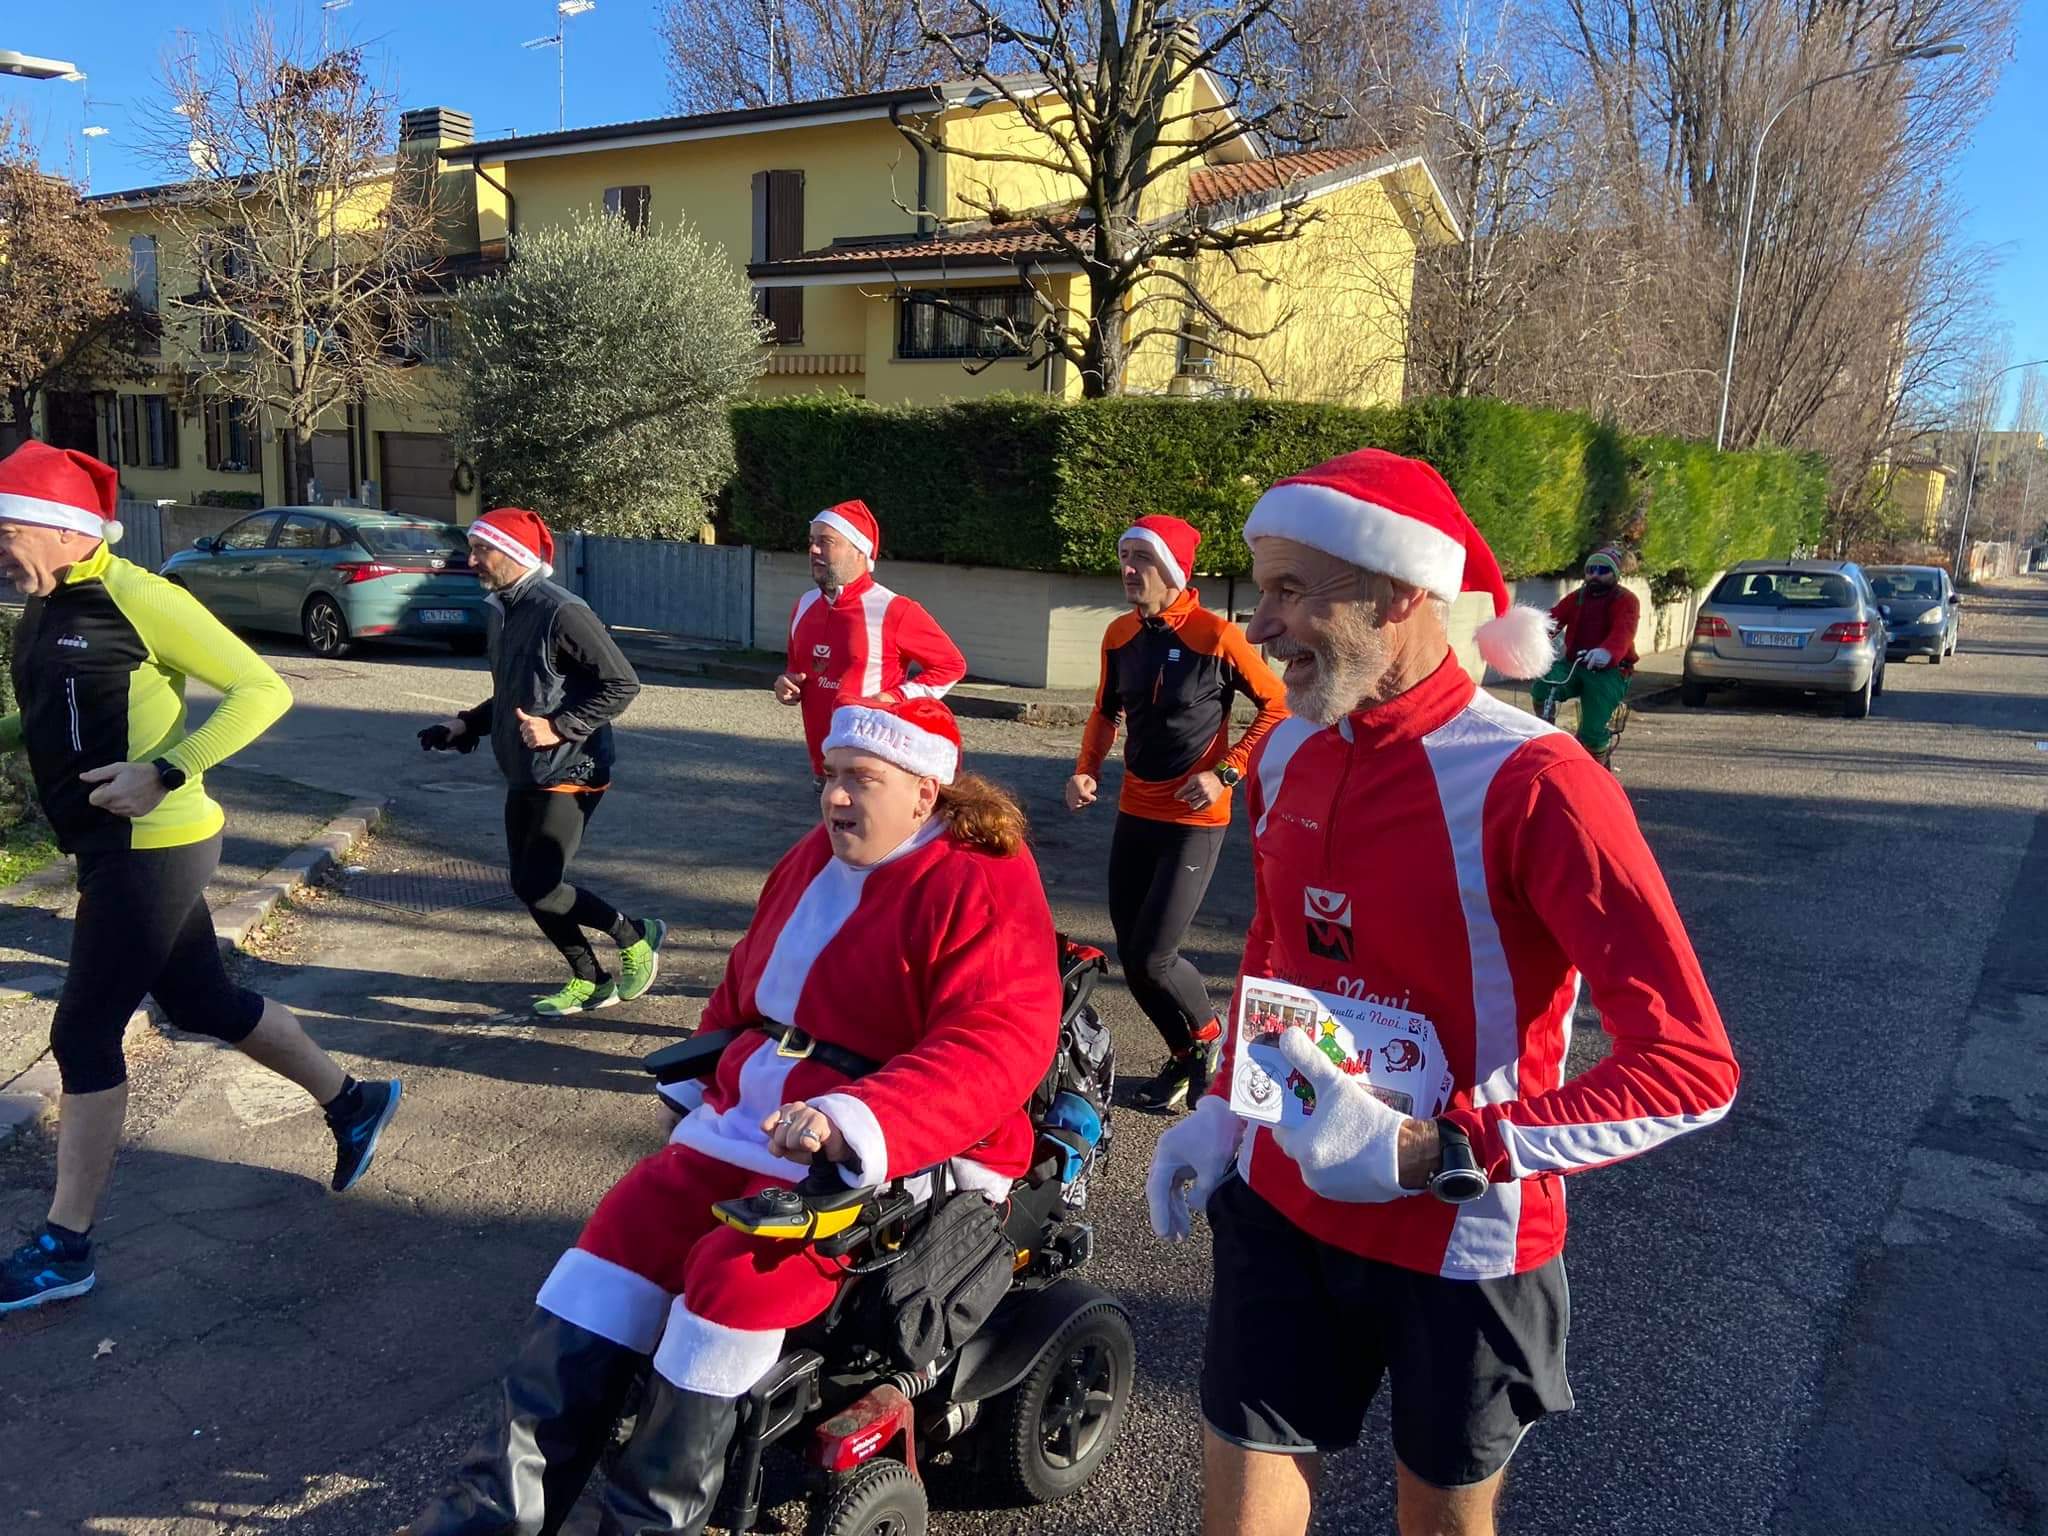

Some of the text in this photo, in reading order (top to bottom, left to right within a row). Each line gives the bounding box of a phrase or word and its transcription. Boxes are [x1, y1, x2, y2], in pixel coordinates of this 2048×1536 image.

[816, 676, 842, 690] Novi
[1337, 976, 1410, 1010] Novi
[1329, 1007, 1354, 1018] quelli
[1356, 1012, 1366, 1021] di
